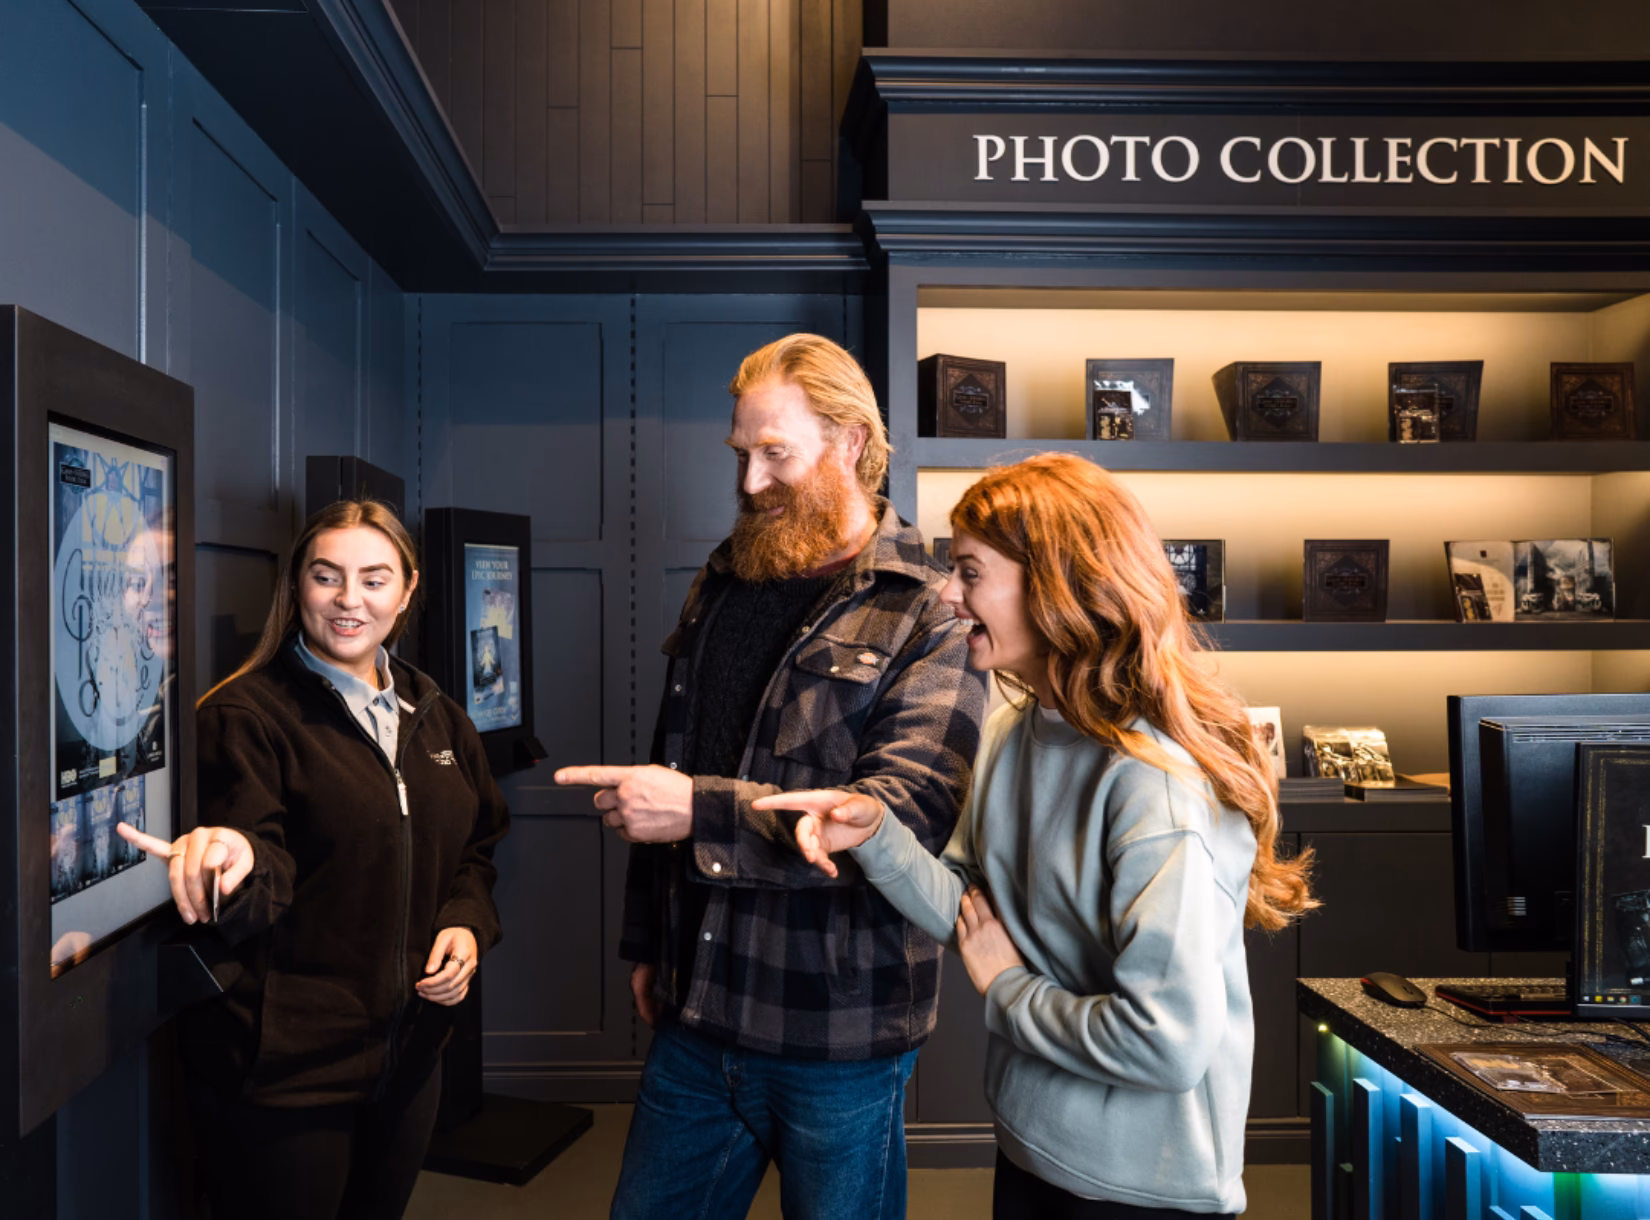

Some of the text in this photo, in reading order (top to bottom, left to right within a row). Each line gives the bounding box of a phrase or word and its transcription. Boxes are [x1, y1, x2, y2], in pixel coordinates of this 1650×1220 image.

[972, 134, 1629, 185] PHOTO COLLECTION
[475, 560, 509, 570] VIEW YOUR
